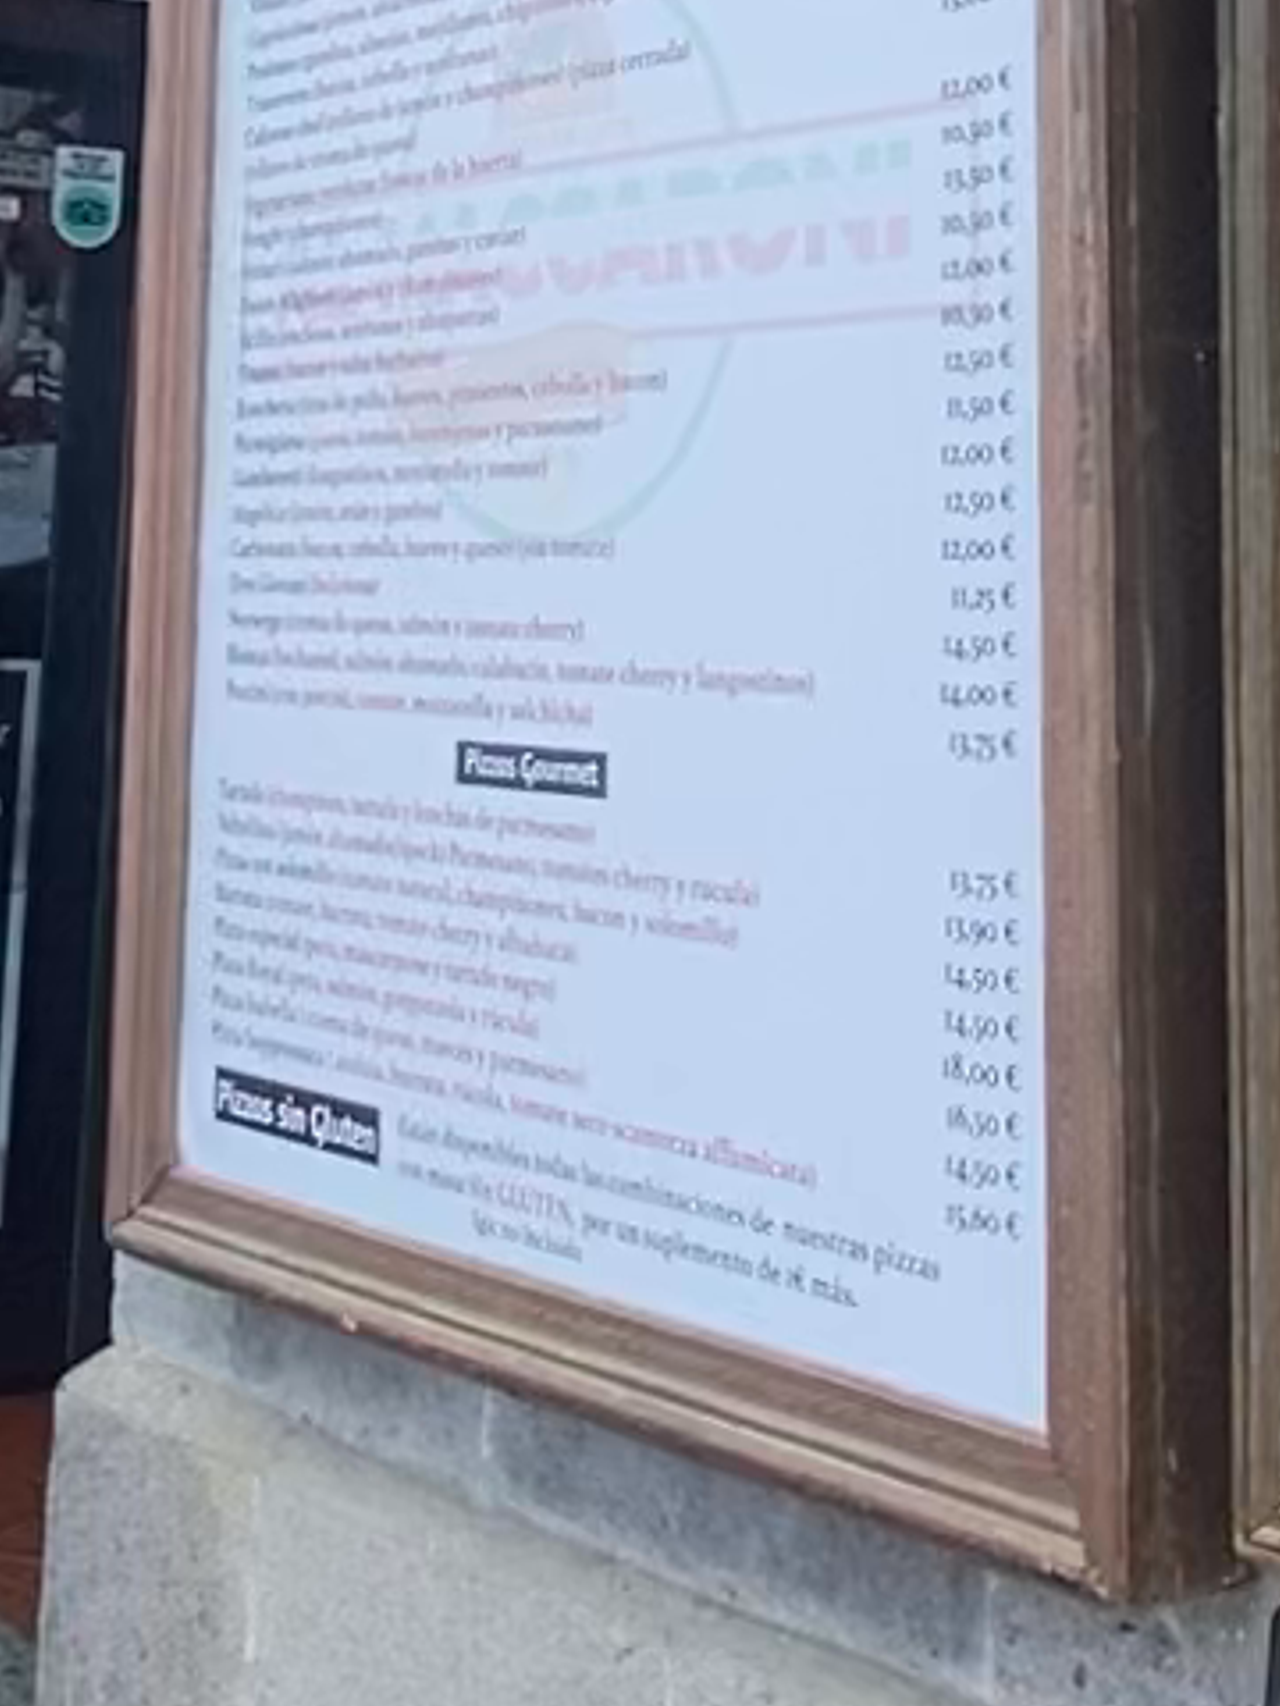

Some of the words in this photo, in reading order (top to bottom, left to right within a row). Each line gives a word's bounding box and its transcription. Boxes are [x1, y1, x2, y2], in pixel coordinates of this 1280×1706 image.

[994, 65, 1010, 91] €
[995, 155, 1013, 183] €
[996, 248, 1014, 274] €
[996, 343, 1013, 368] €
[997, 389, 1015, 416] €
[997, 436, 1014, 464] €
[1000, 484, 1016, 513] €
[1000, 532, 1015, 561] €
[1000, 581, 1016, 610] €
[998, 631, 1017, 659] €
[999, 681, 1017, 708] €
[1001, 729, 1016, 758] €
[519, 750, 601, 787] Gourmet
[1002, 870, 1018, 899] €
[1004, 918, 1019, 947] €
[1001, 966, 1021, 995] €
[1004, 1013, 1021, 1046] €
[1001, 1062, 1022, 1094] €
[217, 1082, 275, 1127] Pizzas
[277, 1095, 306, 1135] sin
[309, 1103, 377, 1155] Gluten
[1001, 1160, 1022, 1193] €
[873, 1239, 942, 1285] pizzas
